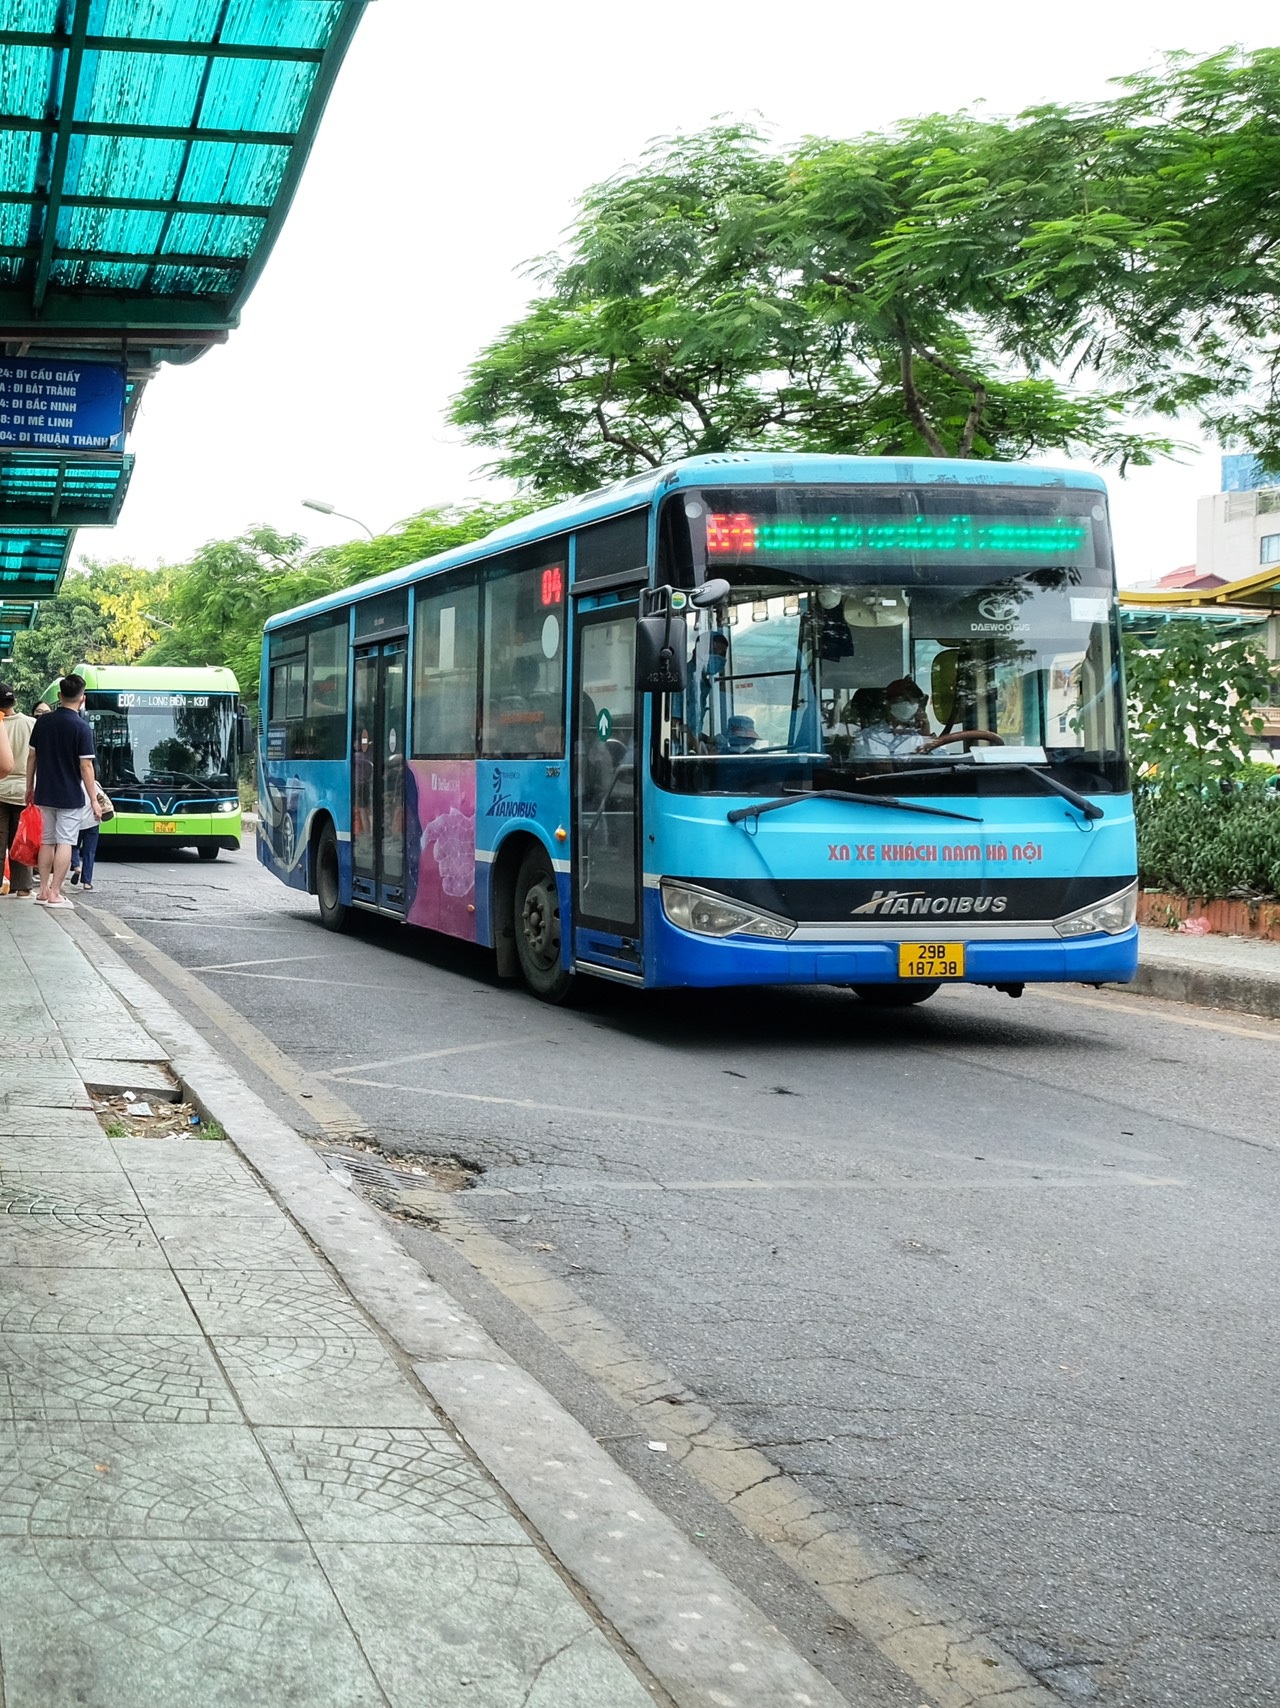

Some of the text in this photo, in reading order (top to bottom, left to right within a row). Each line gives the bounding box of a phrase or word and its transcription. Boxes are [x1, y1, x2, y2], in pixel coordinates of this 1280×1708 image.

[16, 369, 27, 379] ĐI
[56, 369, 81, 382] GIẤY
[13, 383, 23, 393] ĐI
[25, 383, 44, 394] BÁT
[46, 385, 76, 396] TRÀNG
[12, 399, 23, 409] ĐI
[50, 401, 77, 412] NINH
[13, 415, 24, 425] ĐI
[27, 415, 45, 426] MÊ
[48, 417, 73, 428] LINH
[19, 432, 31, 442] ĐI
[34, 432, 70, 448] THUẬN
[72, 434, 108, 446] THÀNH
[970, 623, 1012, 631] DAEWOO
[118, 693, 135, 707] E02
[148, 696, 168, 706] LONG
[485, 794, 537, 818] HANOIBUS
[855, 844, 875, 861] XE
[881, 841, 937, 861] KHÁCH
[986, 840, 1008, 861] HÀ
[850, 890, 1008, 914] HANOIBUS
[918, 945, 946, 959] 29B
[908, 961, 957, 975] 187.38
